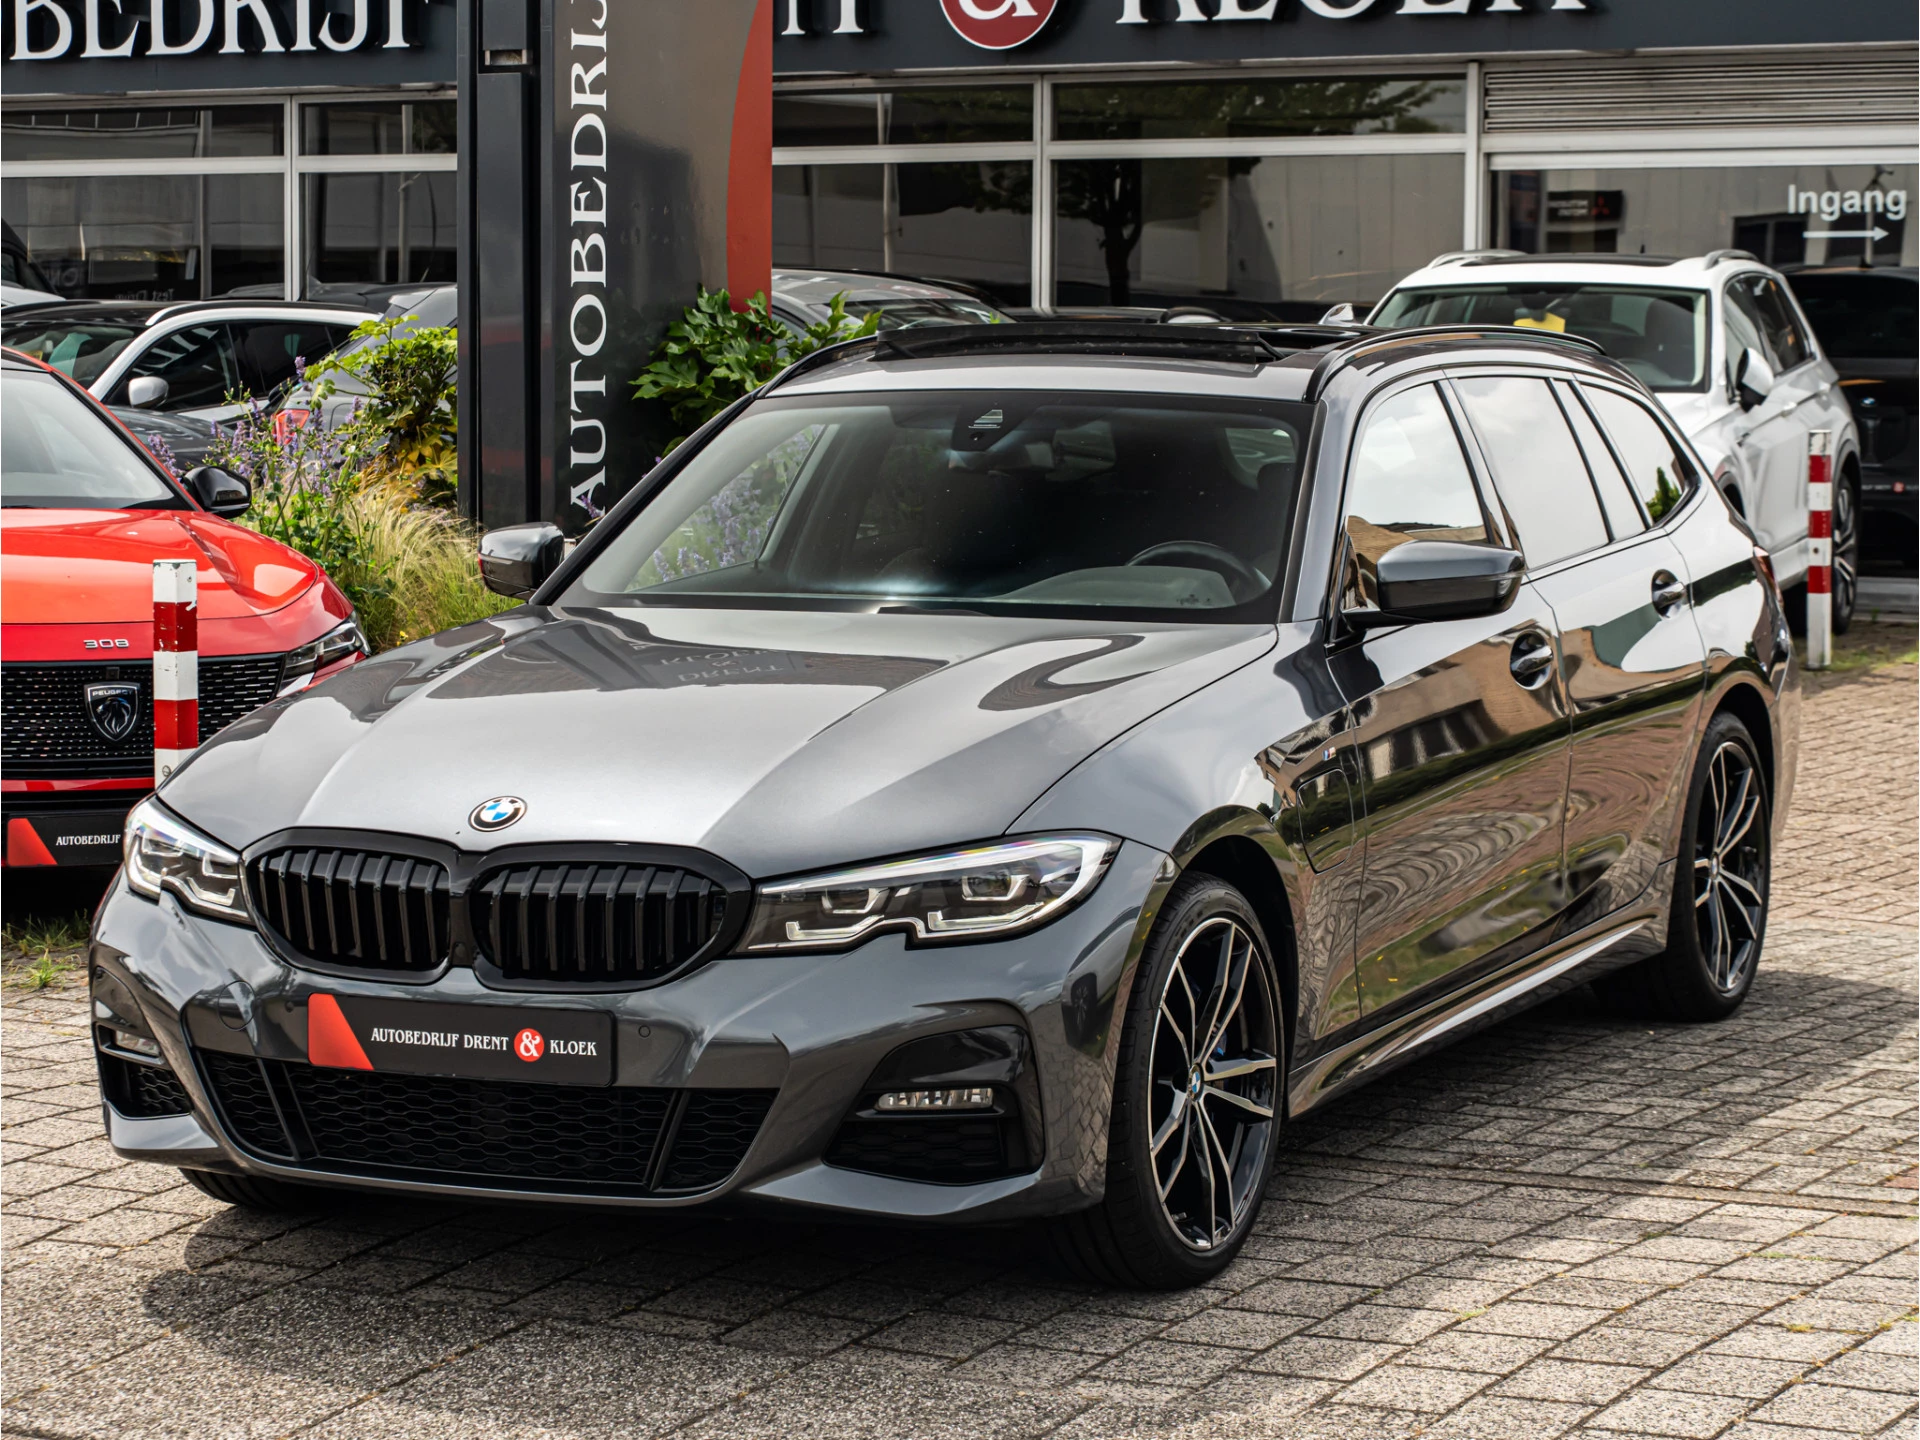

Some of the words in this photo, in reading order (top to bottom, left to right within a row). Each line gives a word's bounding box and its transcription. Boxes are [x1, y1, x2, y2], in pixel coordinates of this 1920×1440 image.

[1787, 184, 1907, 221] Ingang
[83, 639, 129, 649] 308
[56, 834, 121, 846] AUTOBEDRIJF
[370, 1027, 460, 1047] AUTOBEDRIJF
[463, 1034, 509, 1050] DRENT
[519, 1031, 541, 1057] &
[549, 1039, 598, 1056] KLOEK
